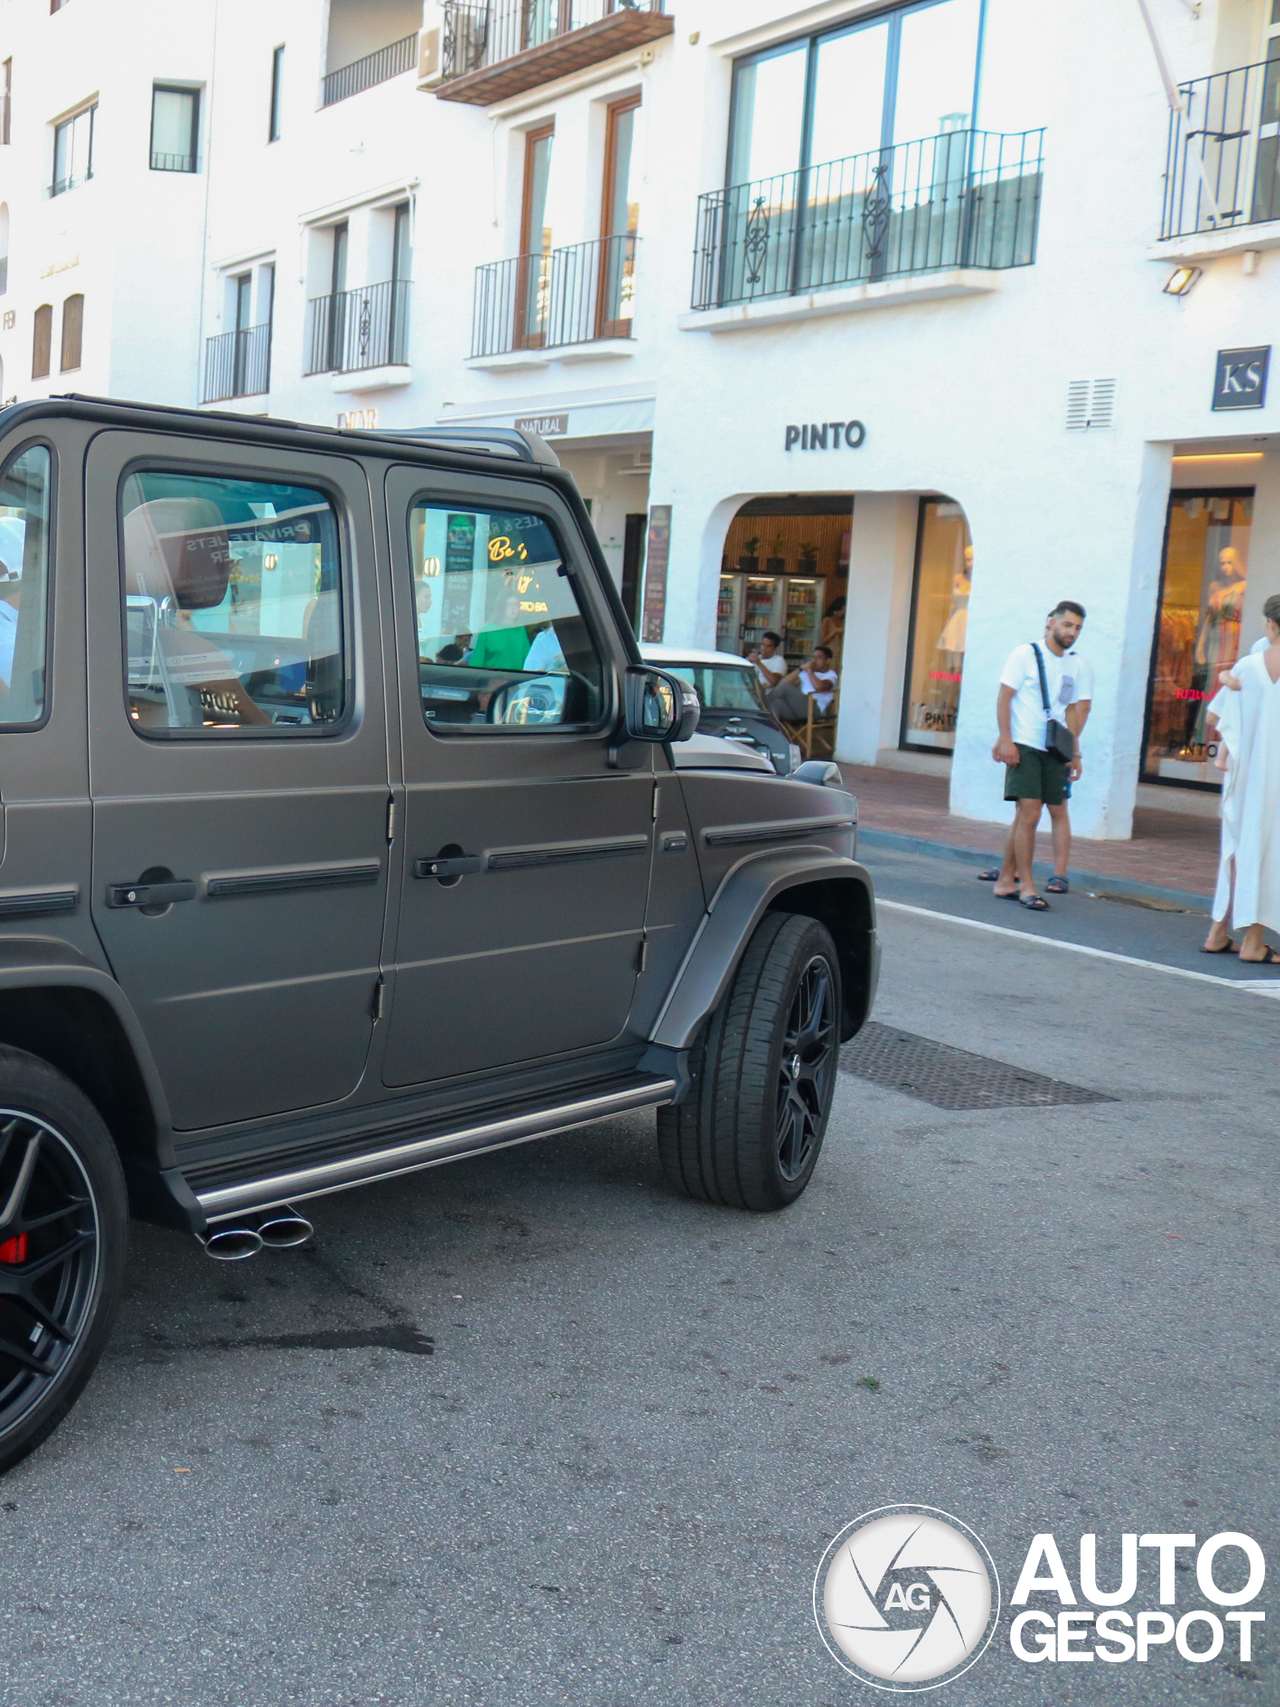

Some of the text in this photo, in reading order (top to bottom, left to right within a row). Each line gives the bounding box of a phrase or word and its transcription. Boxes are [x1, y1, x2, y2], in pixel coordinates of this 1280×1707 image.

[1222, 361, 1261, 394] KS
[520, 418, 561, 434] NATURAL
[785, 419, 866, 451] PINTO
[1169, 740, 1218, 757] PINTO
